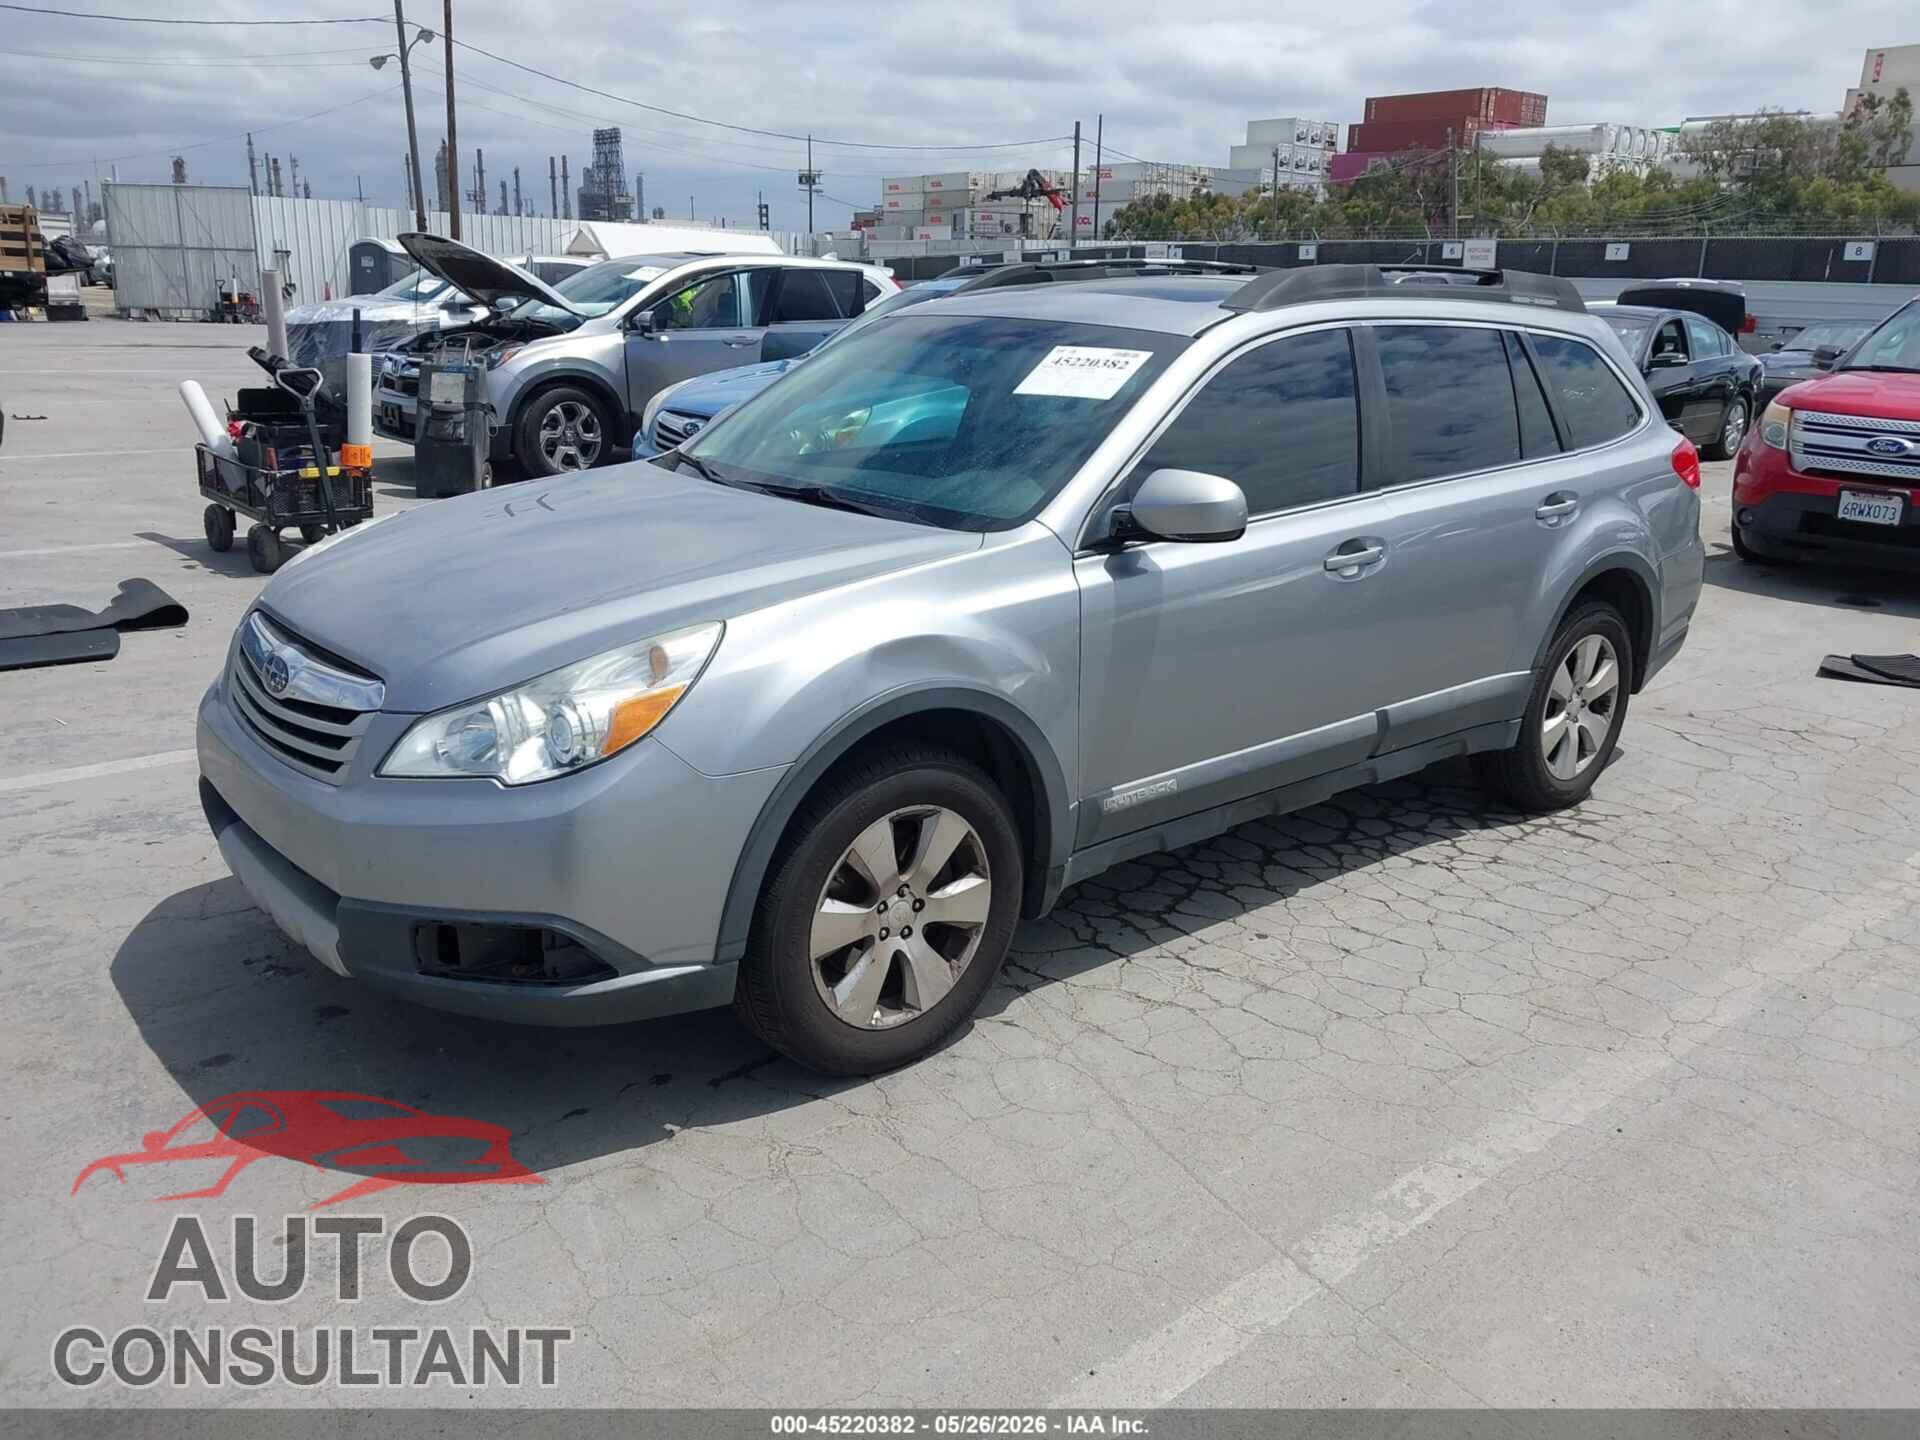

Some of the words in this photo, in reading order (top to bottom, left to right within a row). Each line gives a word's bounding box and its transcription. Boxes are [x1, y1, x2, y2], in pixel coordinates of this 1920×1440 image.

[1613, 247, 1621, 256] 7
[1855, 246, 1863, 256] 8
[1053, 356, 1130, 370] 45220382
[1842, 502, 1897, 520] 6RWX073
